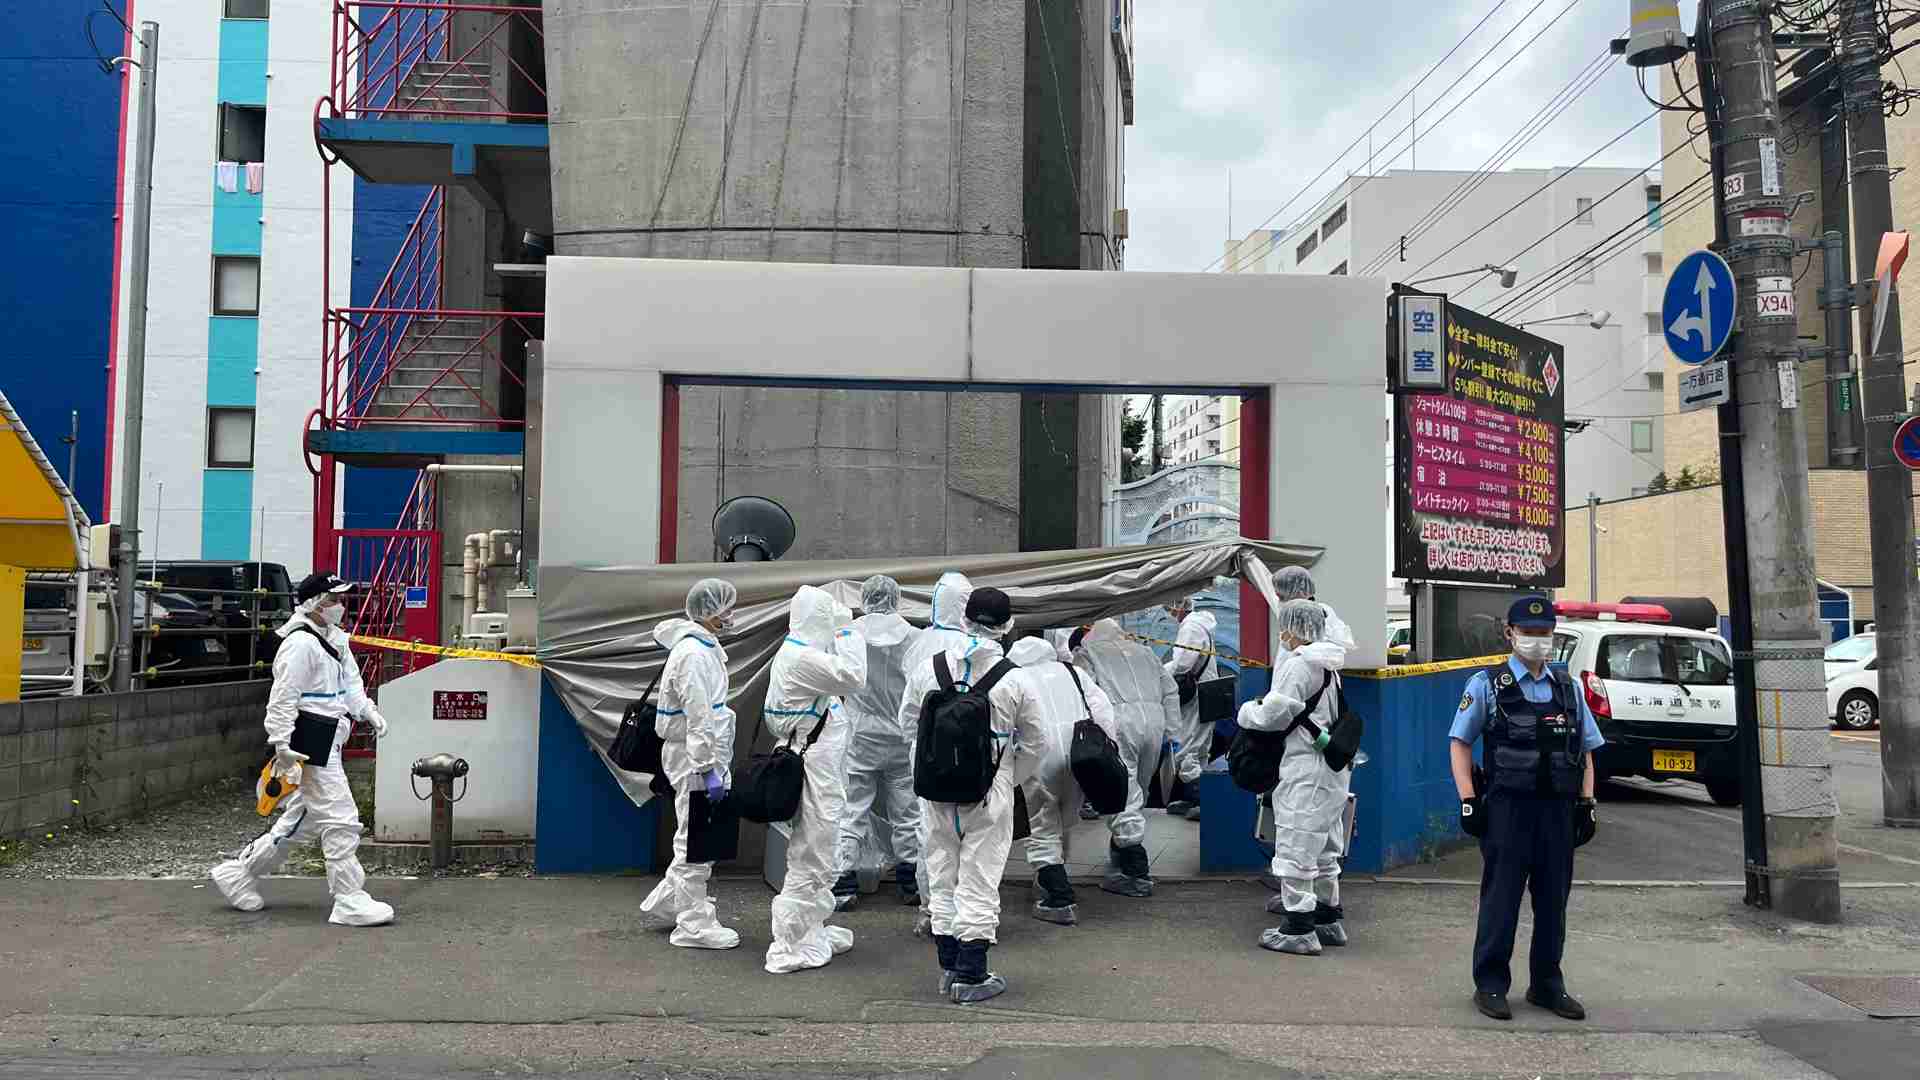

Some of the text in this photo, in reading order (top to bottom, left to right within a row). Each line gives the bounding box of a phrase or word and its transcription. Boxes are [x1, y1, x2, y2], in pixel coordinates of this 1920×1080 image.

[1412, 309, 1435, 372] 空室
[1416, 442, 1465, 465] サービスタイム
[1416, 491, 1470, 513] レイトチェックイン
[1627, 695, 1721, 710] 北海道警察
